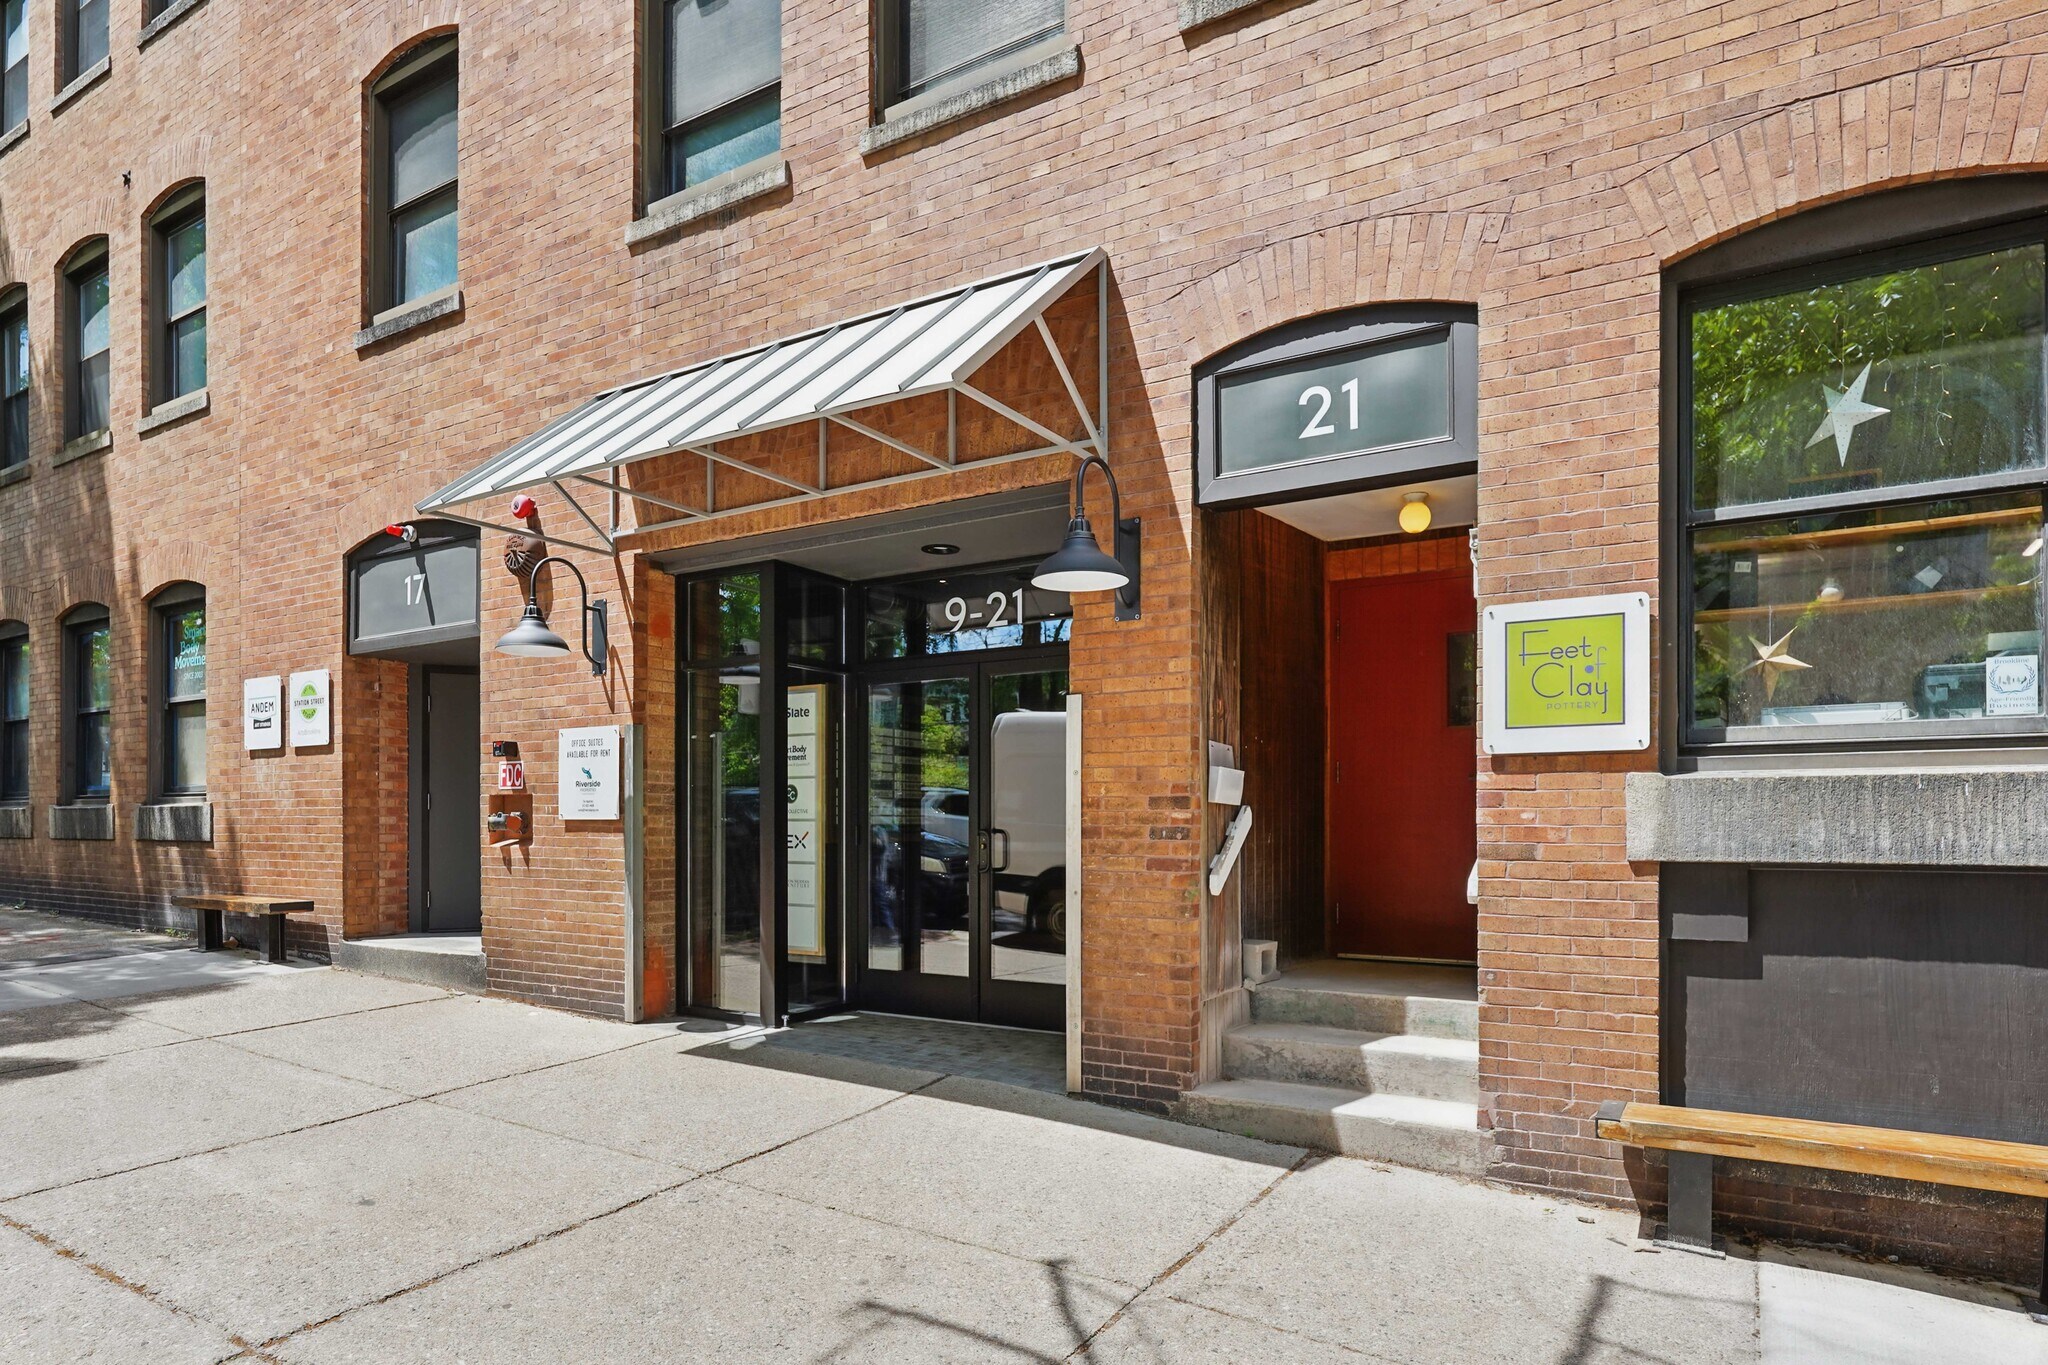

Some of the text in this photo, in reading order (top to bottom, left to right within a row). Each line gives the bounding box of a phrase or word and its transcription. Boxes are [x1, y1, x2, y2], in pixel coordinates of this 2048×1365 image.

[1298, 377, 1359, 440] 21
[404, 573, 426, 606] 17
[944, 588, 1024, 633] 9-21
[180, 640, 200, 657] Body
[1518, 629, 1593, 667] Feet
[174, 654, 206, 670] Moveme
[1531, 661, 1609, 715] Clay
[250, 701, 275, 714] ANDEM
[294, 697, 325, 707] STATION STREET
[1546, 701, 1598, 711] POTTERY
[571, 738, 604, 748] OFFICE SUITES
[792, 745, 807, 755] Body
[566, 748, 611, 758] AVAILABLE FOR RENT
[500, 763, 522, 787] FDC
[575, 780, 601, 788] Riverside
